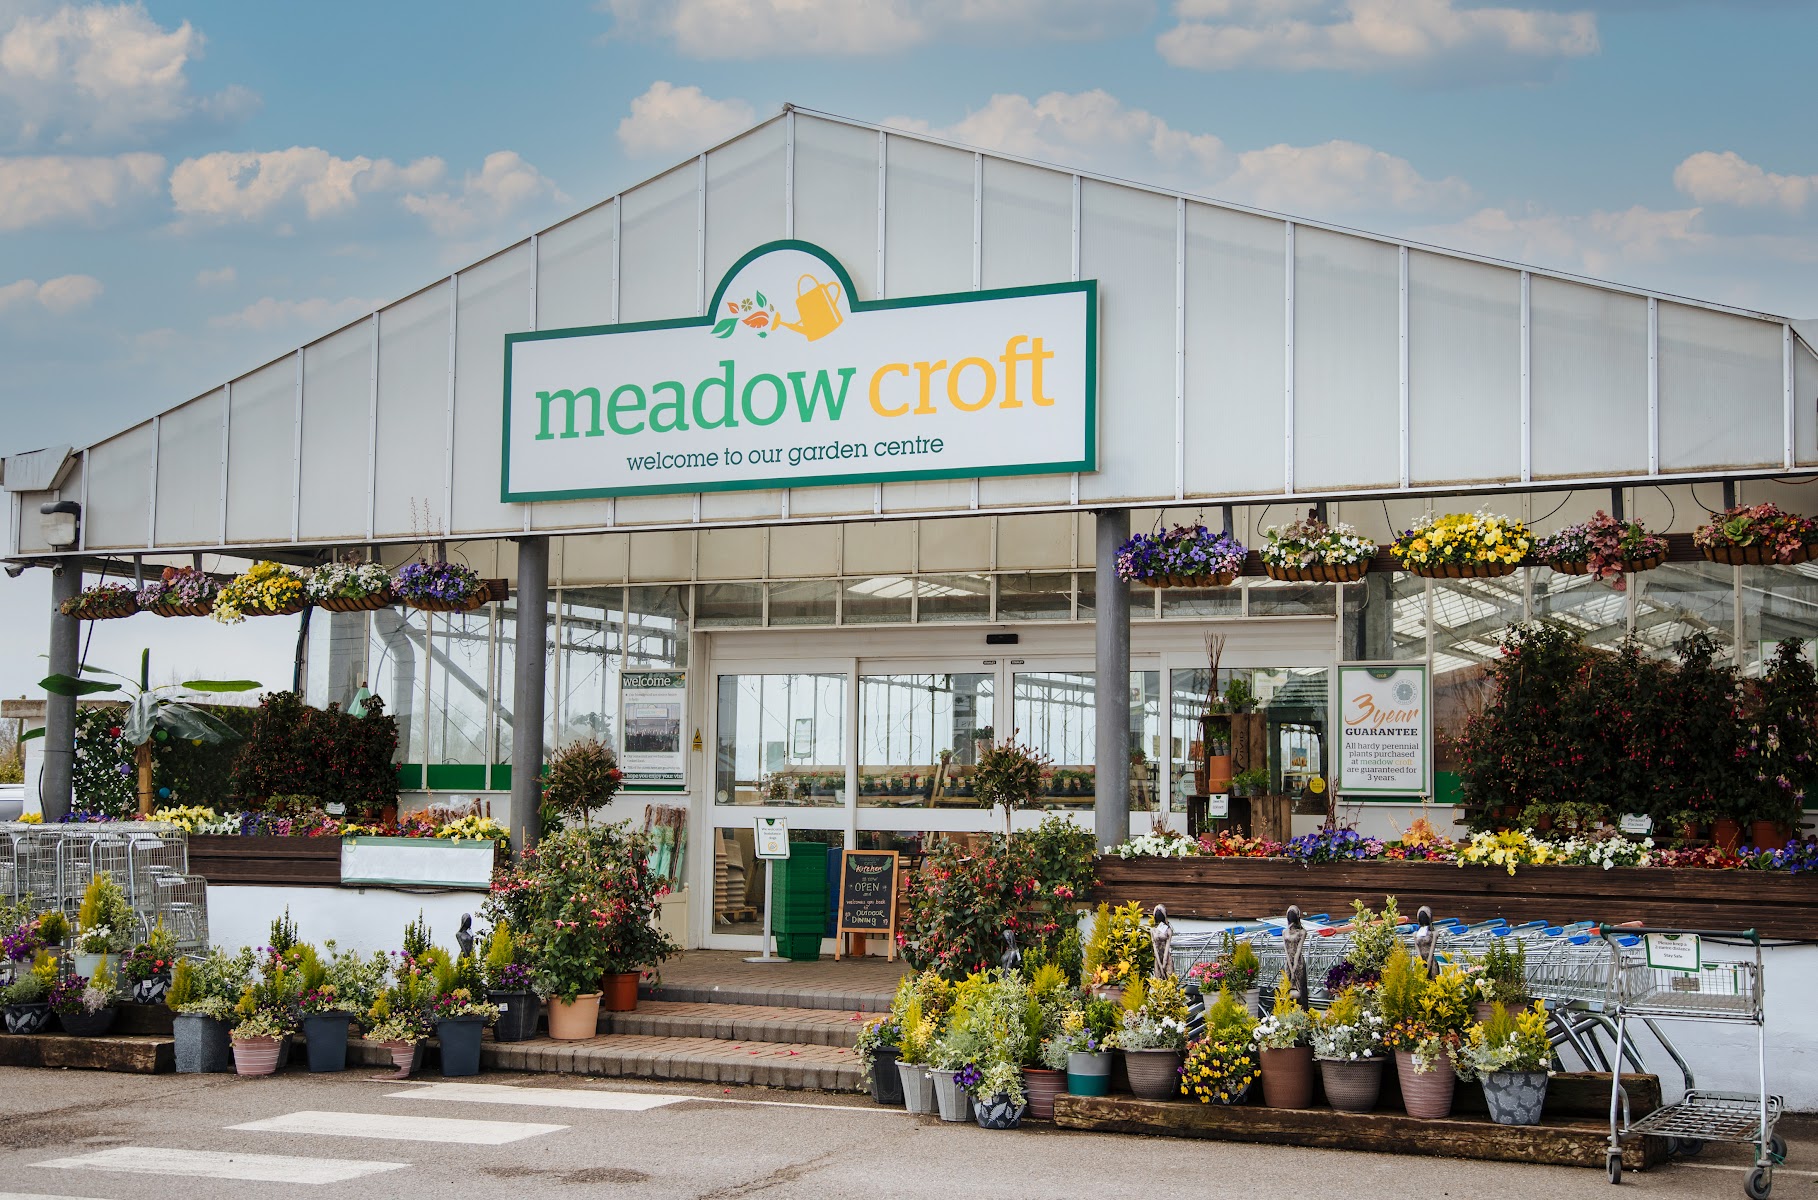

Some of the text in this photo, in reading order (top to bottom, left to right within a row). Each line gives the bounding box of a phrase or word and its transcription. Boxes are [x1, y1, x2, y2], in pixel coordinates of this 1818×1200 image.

[535, 335, 1054, 440] meadow croft
[627, 435, 944, 471] welcome to our garden centre
[623, 676, 671, 687] welcome
[1345, 693, 1419, 730] 3 year
[1345, 728, 1418, 736] GUARANTEE
[1357, 742, 1380, 750] hardy
[1349, 750, 1373, 758] plants
[1360, 766, 1405, 774] guaranteed
[855, 882, 880, 891] OPEN
